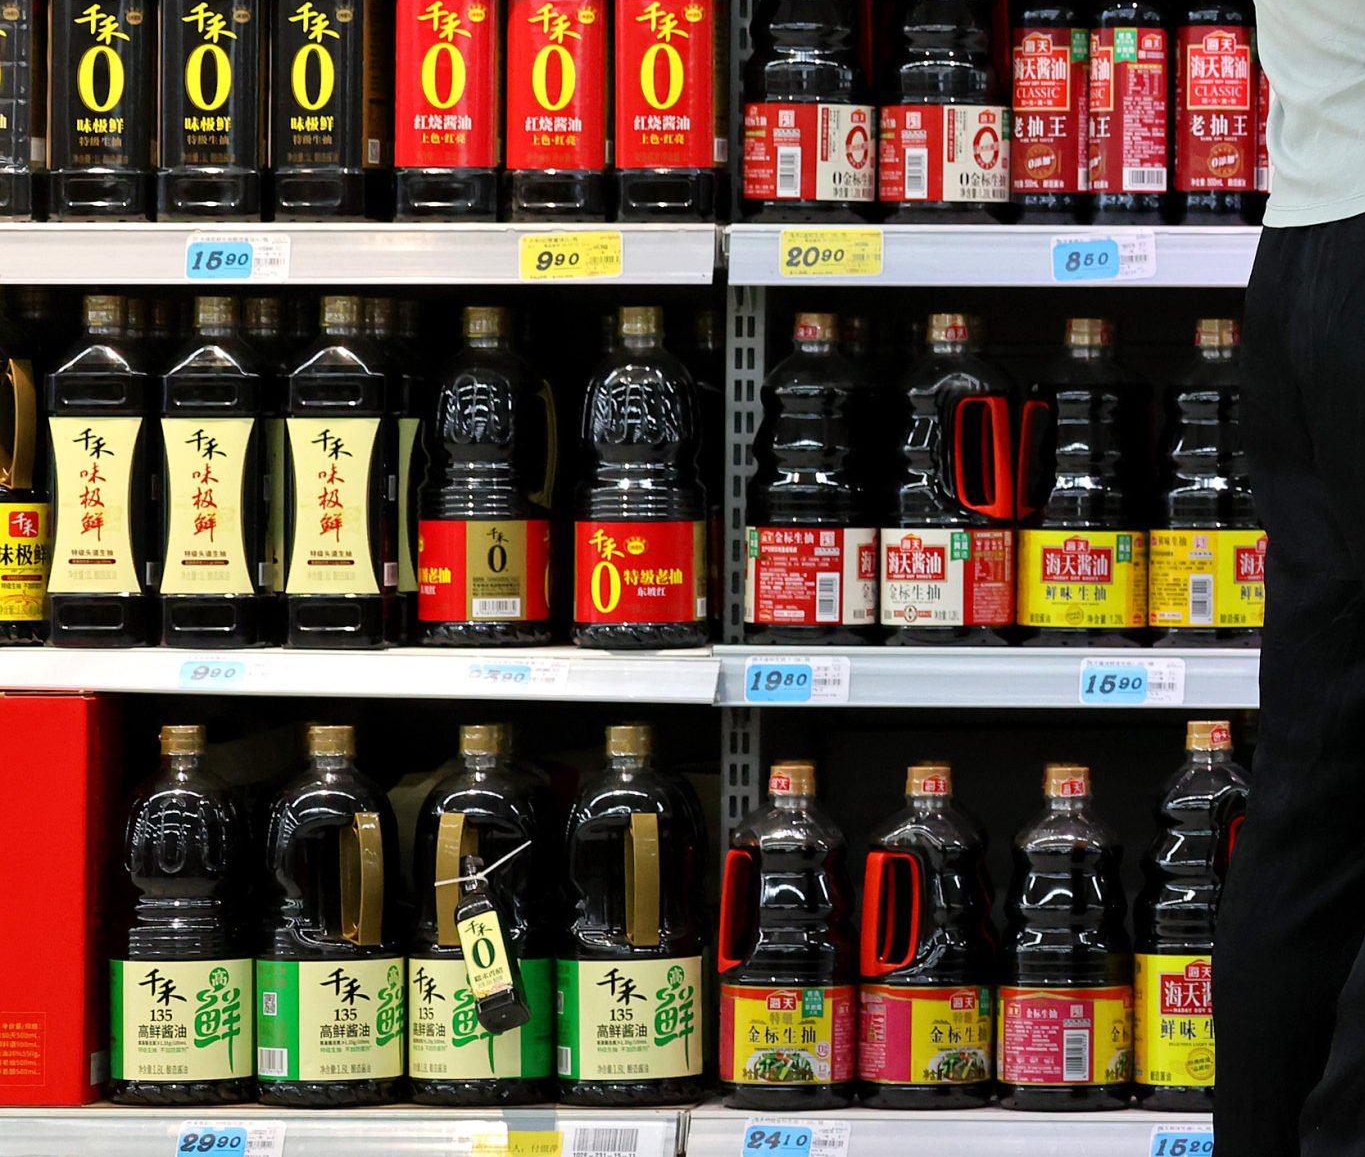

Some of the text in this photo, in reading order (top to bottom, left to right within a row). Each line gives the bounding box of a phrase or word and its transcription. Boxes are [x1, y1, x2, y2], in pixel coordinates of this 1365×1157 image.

[78, 45, 125, 112] 0
[1189, 113, 1249, 138] 老抽王
[149, 1007, 173, 1022] 135
[333, 1007, 358, 1022] 135
[608, 1007, 634, 1022] 135
